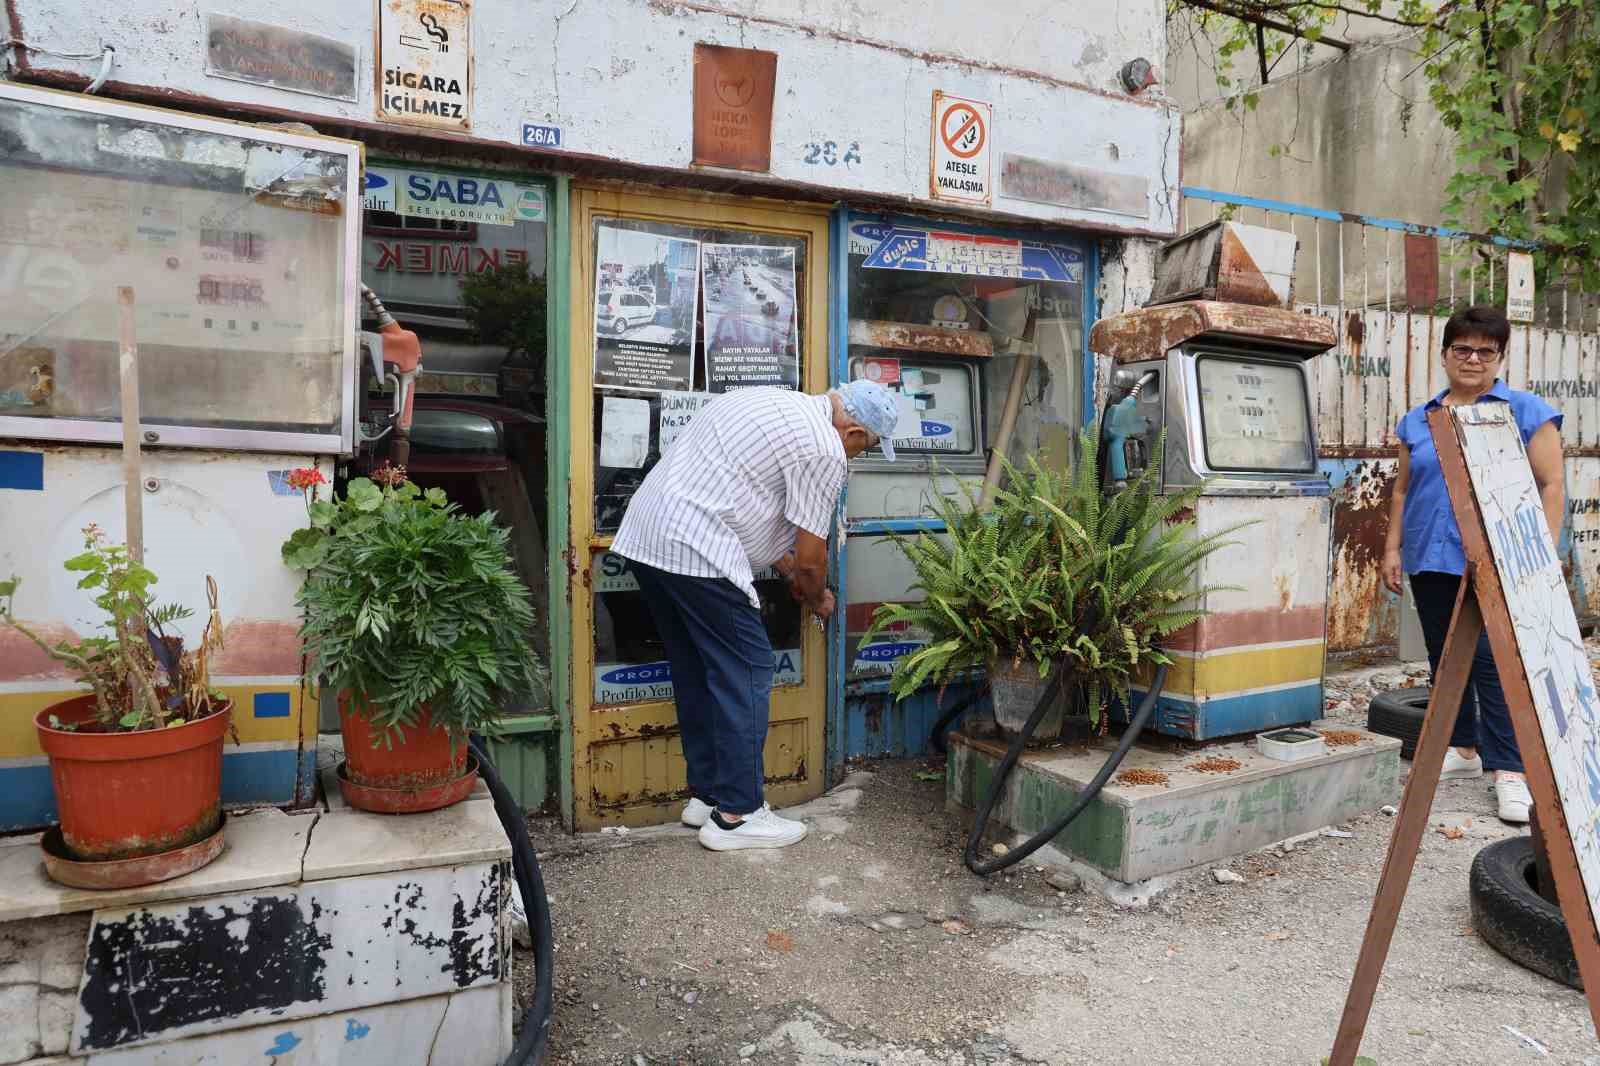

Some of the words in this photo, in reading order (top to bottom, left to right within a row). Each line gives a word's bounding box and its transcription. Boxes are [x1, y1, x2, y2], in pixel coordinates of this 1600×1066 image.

[385, 66, 462, 95] SİGARA
[384, 89, 463, 118] İÇİLMEZ
[526, 127, 557, 145] 26/A
[945, 160, 977, 177] ATEŞLE
[408, 174, 504, 208] SABA
[937, 176, 984, 193] YAKLAŞMA
[1336, 355, 1391, 377] YASAK
[661, 396, 698, 411] DÜNYA
[1573, 528, 1600, 543] PETR
[601, 687, 647, 703] Profilo
